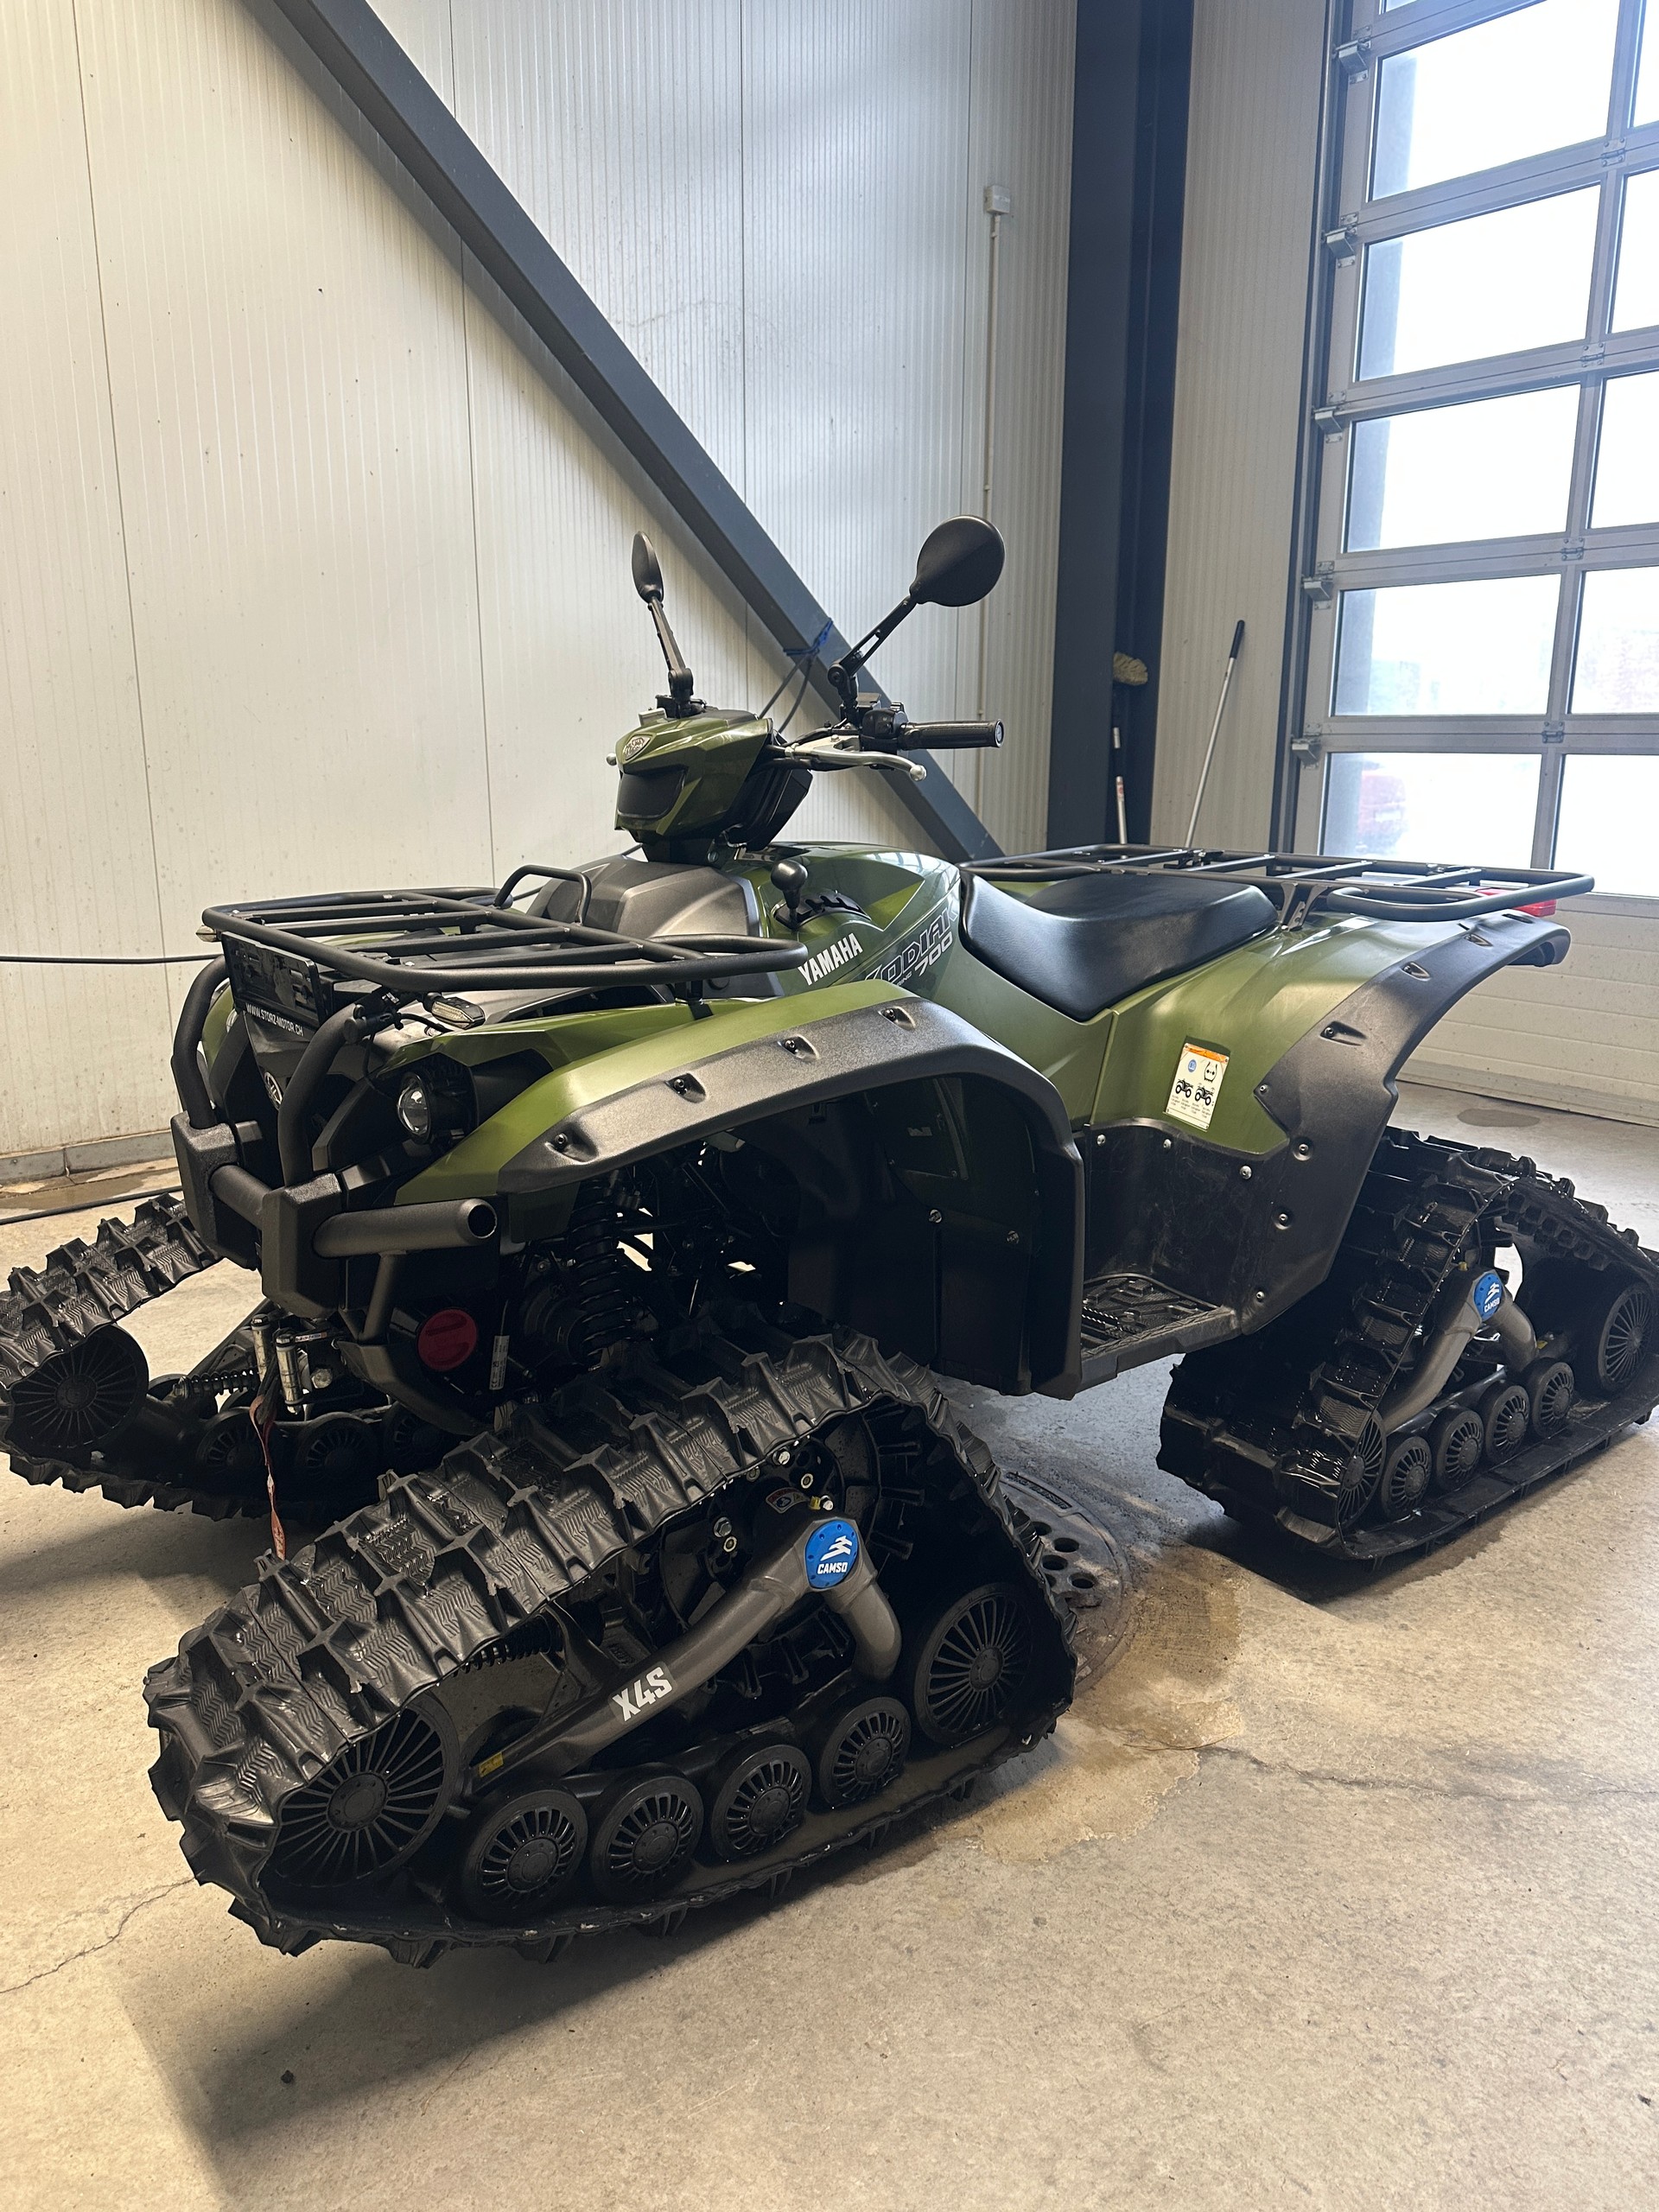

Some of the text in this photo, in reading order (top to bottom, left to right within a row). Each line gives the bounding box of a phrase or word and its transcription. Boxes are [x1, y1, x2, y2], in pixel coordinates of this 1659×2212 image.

[798, 932, 863, 986] YAMAHA
[914, 931, 953, 976] 700
[245, 1002, 304, 1037] WWW.STORZ-MOTOR.CH
[1484, 1297, 1500, 1313] CAMSO
[817, 1561, 848, 1574] CAMSO
[612, 1666, 672, 1721] X4S
